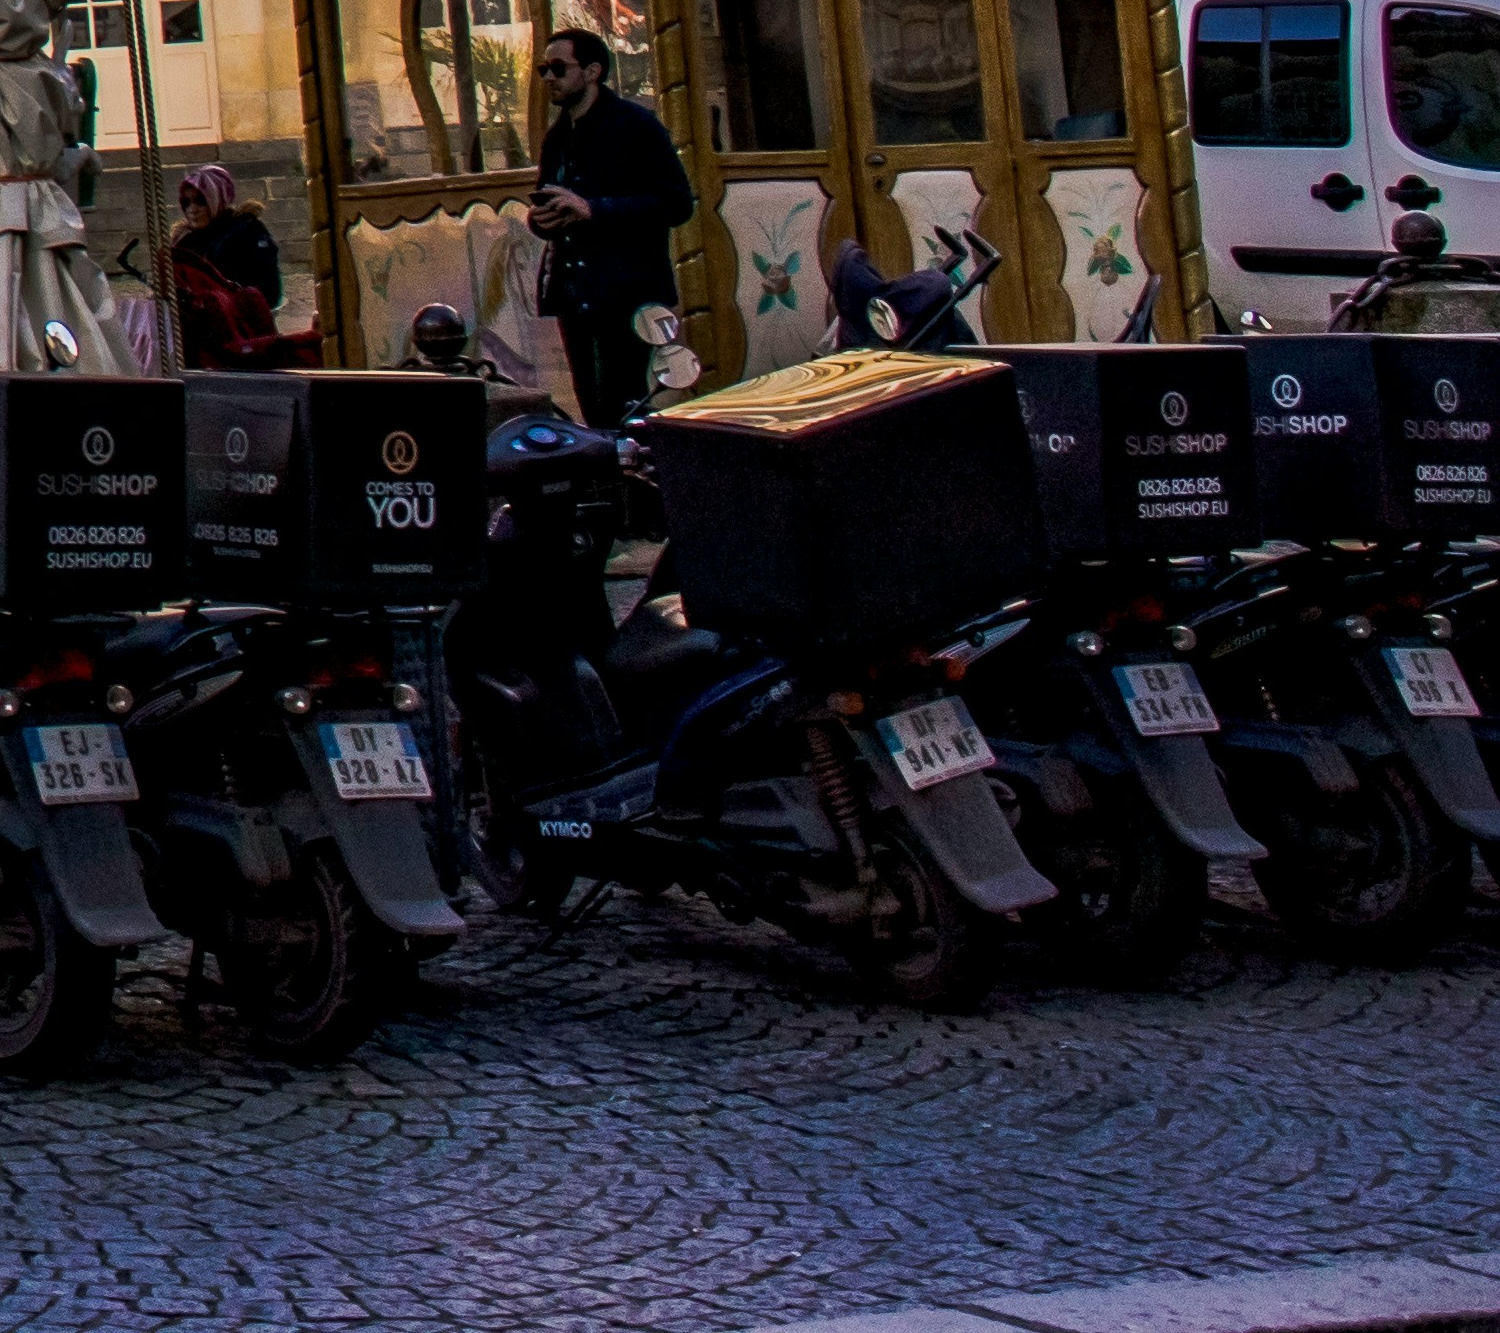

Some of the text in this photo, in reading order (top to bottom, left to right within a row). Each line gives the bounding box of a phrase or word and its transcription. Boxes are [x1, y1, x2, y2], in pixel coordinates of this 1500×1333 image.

[1124, 433, 1230, 456] SUSHISHOP
[1415, 464, 1445, 482] 0826
[1446, 465, 1467, 482] 826
[36, 472, 159, 498] SUSHISHOP
[365, 481, 436, 496] COMES TO
[1138, 479, 1171, 497] 0826
[1171, 477, 1196, 496] 826
[365, 495, 437, 530] YOU
[1138, 499, 1231, 520] SUSHISHOP.EU
[49, 525, 146, 545] 0826 826 826
[46, 551, 152, 570] SUSHISHOP.EU
